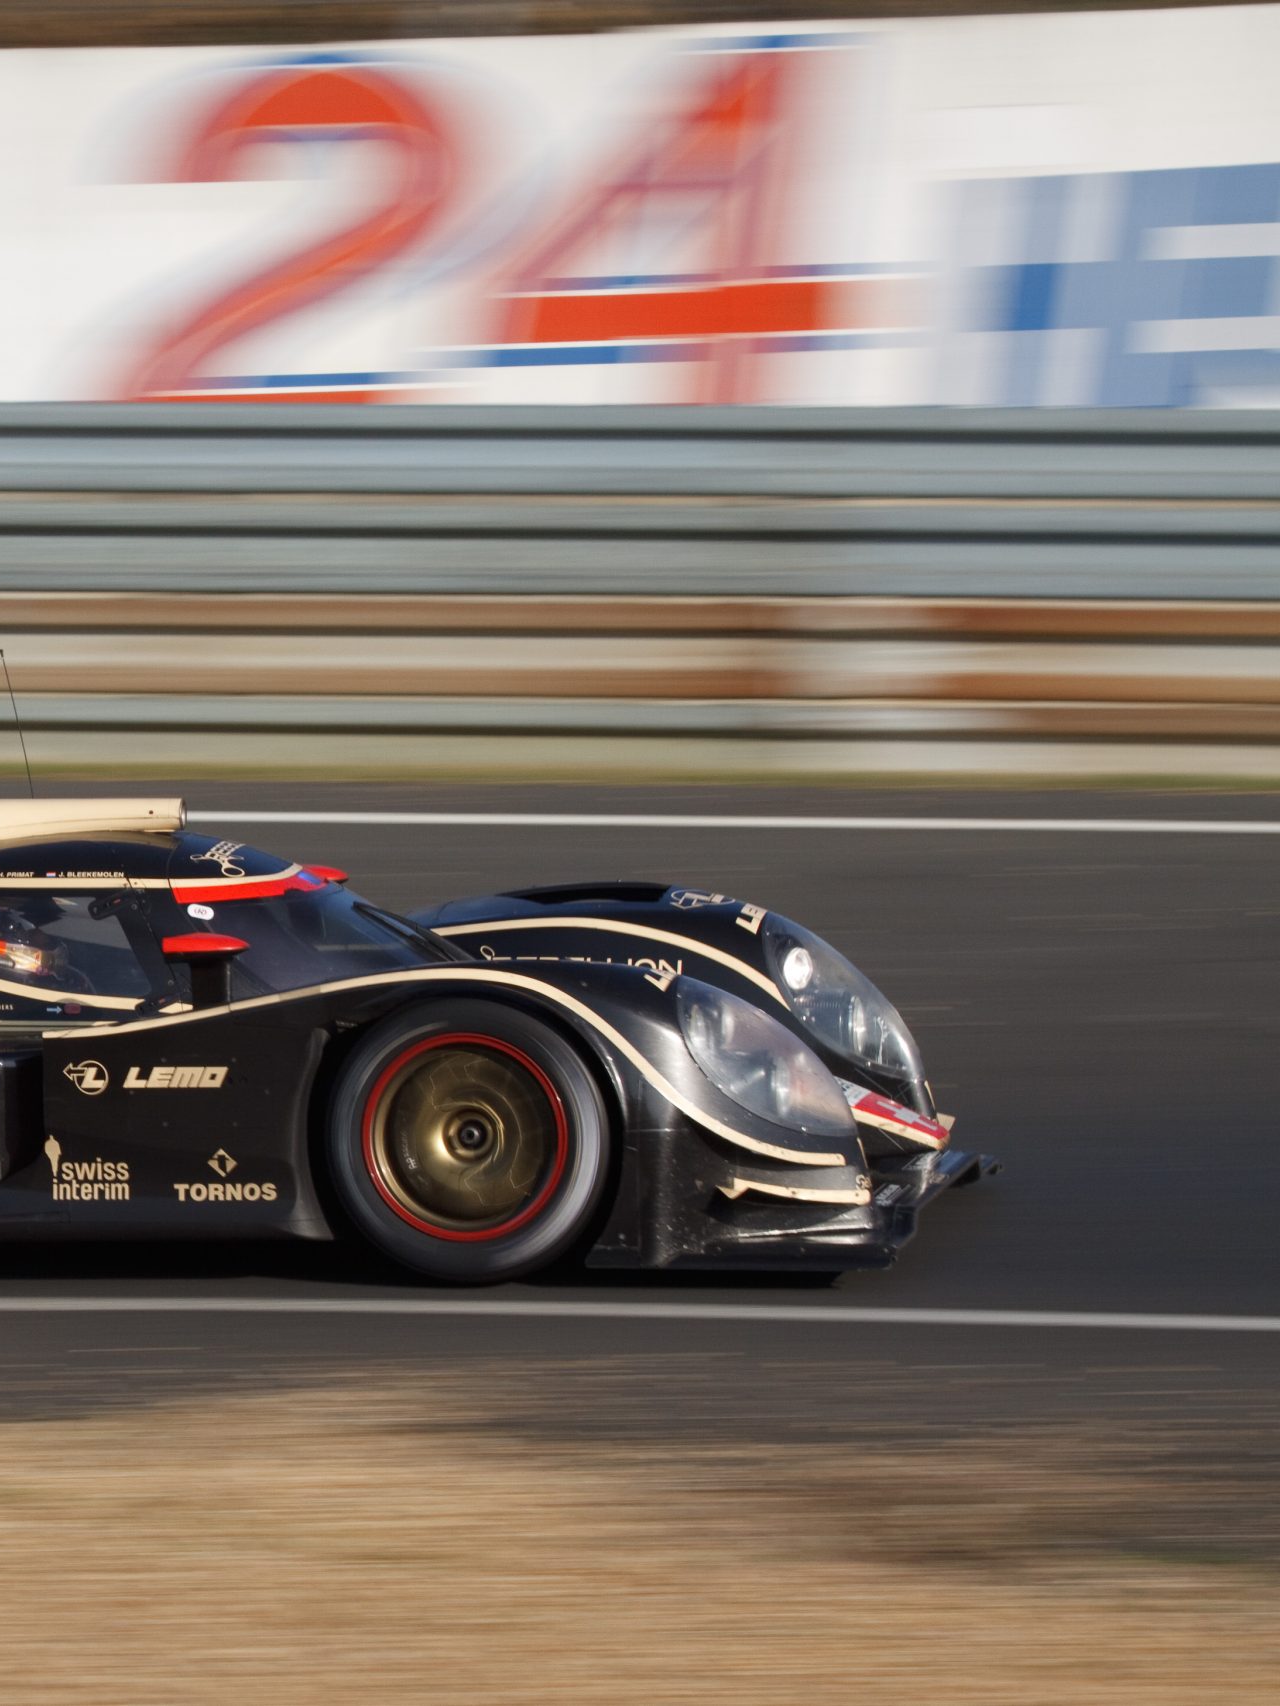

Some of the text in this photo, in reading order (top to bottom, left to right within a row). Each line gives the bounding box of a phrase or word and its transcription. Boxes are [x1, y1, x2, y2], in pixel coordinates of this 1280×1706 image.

[122, 1066, 229, 1089] LEMO
[61, 1157, 130, 1181] swiss
[52, 1179, 130, 1201] interim
[174, 1183, 277, 1201] TORNOS
